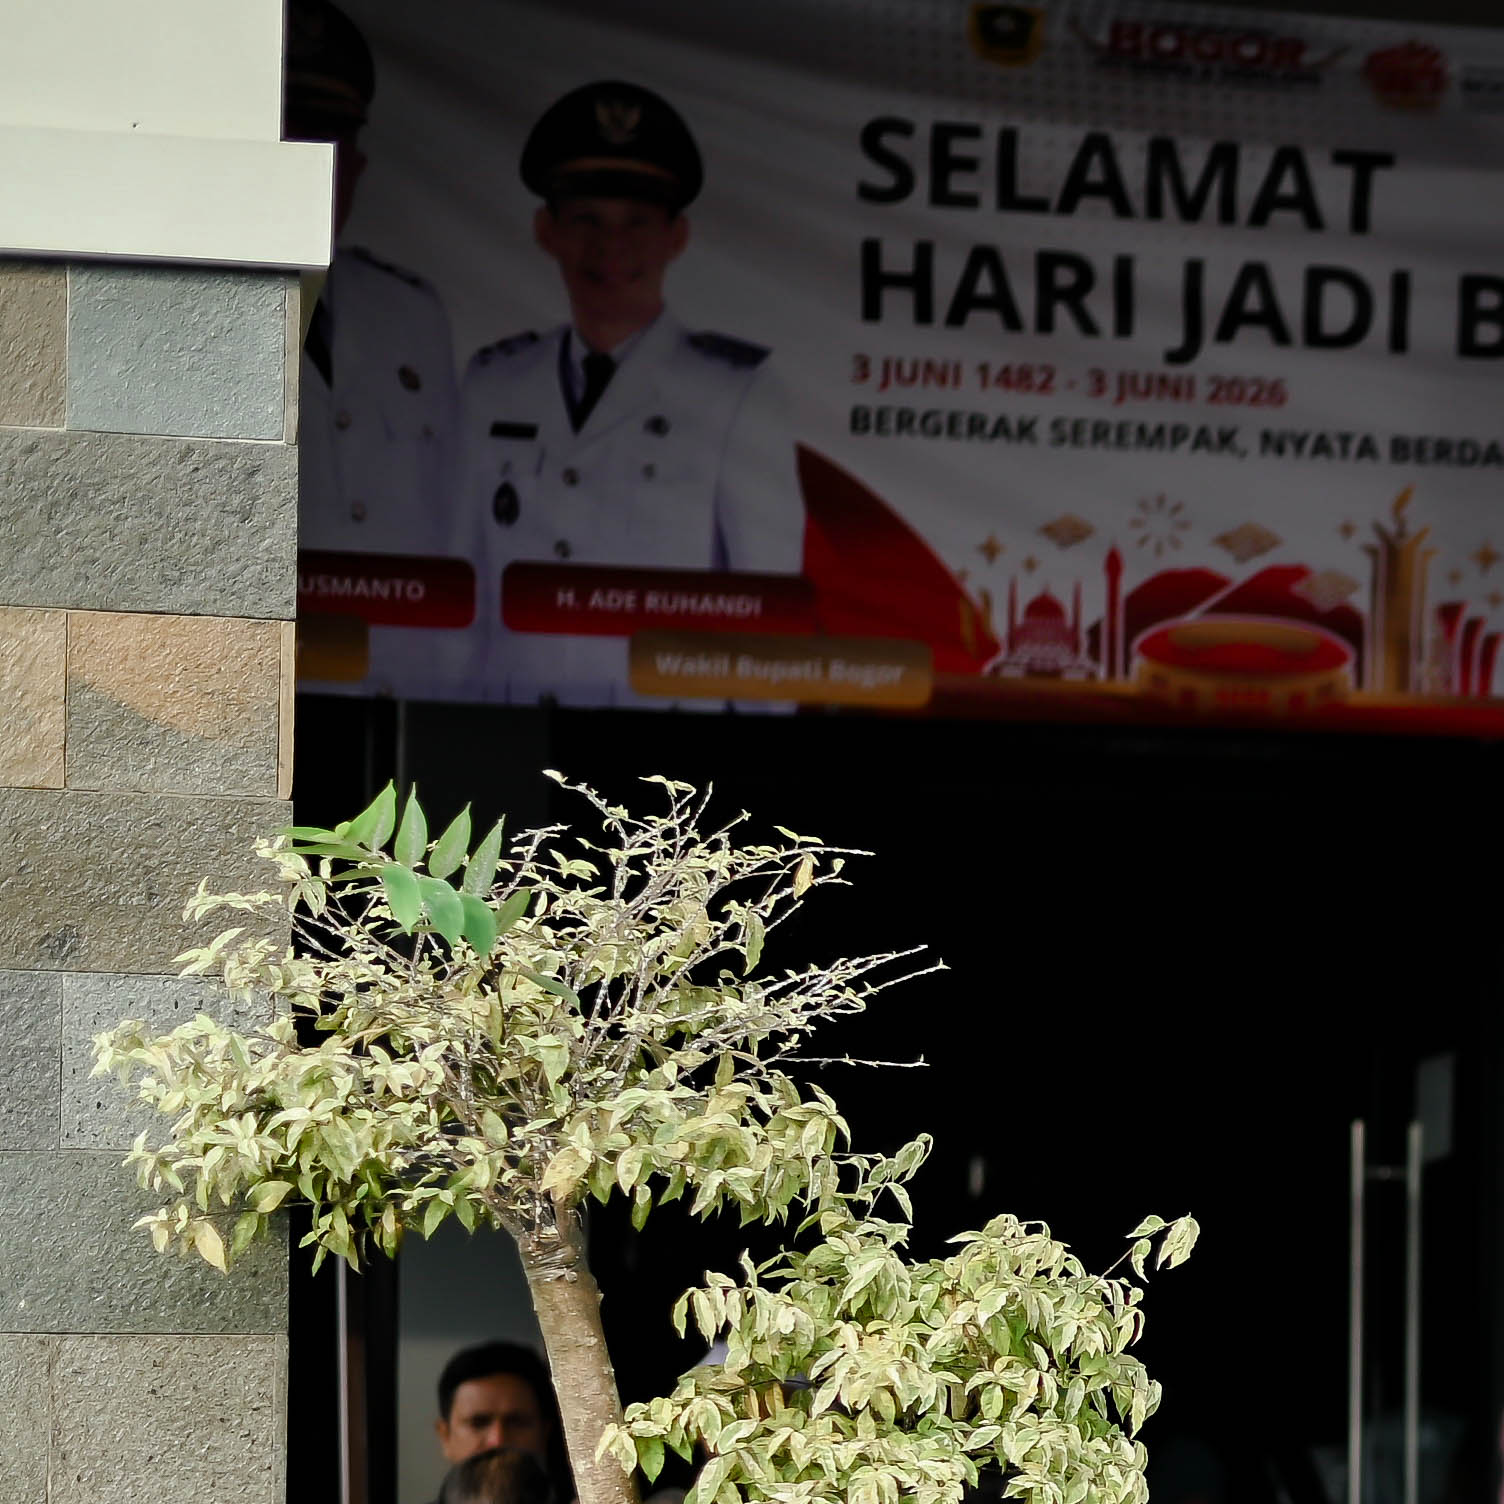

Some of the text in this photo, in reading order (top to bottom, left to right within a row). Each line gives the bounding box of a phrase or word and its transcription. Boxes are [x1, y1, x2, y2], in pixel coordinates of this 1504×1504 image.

[856, 115, 1396, 235] SELAMAT
[859, 237, 1134, 339] HARI
[1163, 253, 1410, 366] JADI
[851, 356, 871, 384] 3
[879, 359, 962, 392] JUNI
[977, 363, 1056, 396] 1482
[1089, 368, 1108, 398] 3
[1115, 371, 1198, 405] JUNI
[1207, 375, 1288, 408] 2026
[849, 405, 1039, 446] BERGERAK
[1048, 415, 1248, 459] SEREMPAK,
[1259, 429, 1380, 463] NYATA
[556, 586, 763, 619] H. ADE RUHANDI
[655, 650, 906, 689] Wakil Bupati Bogor
